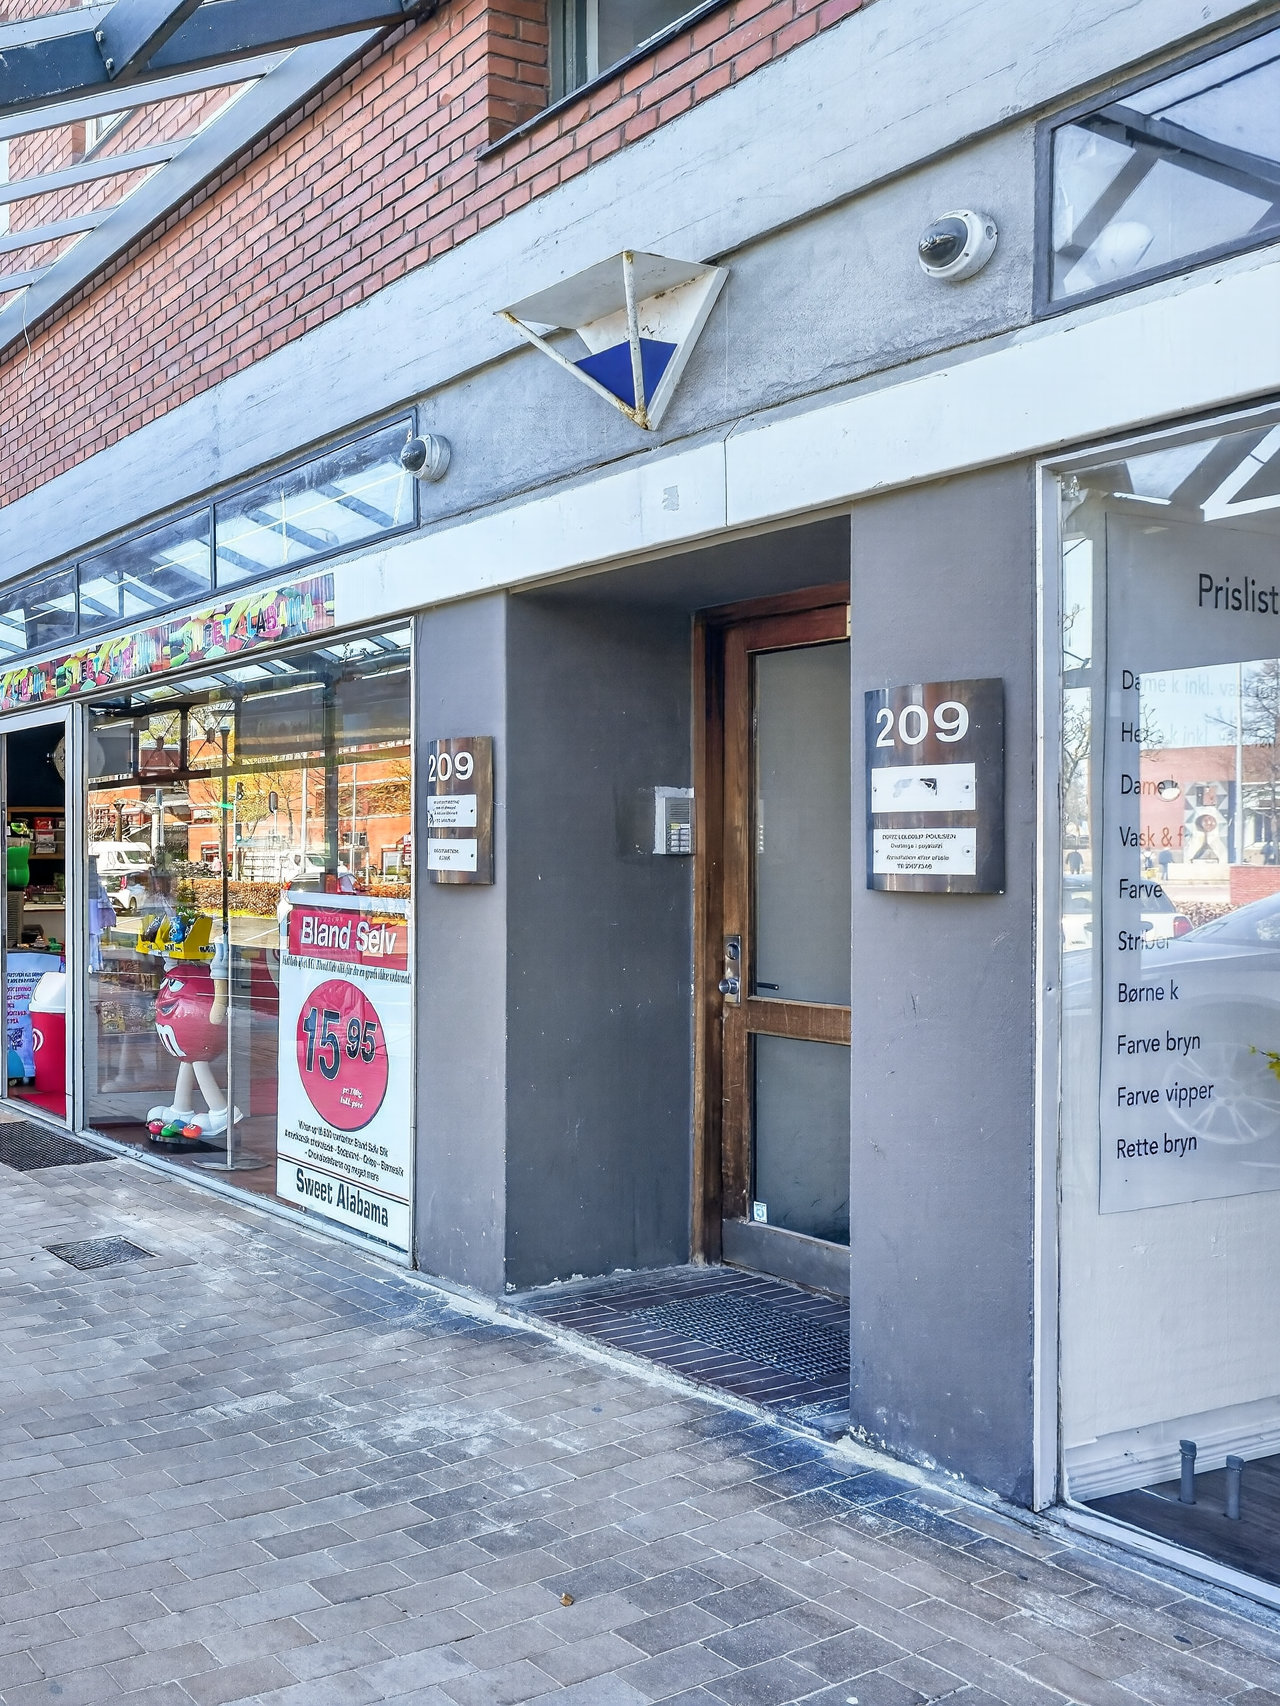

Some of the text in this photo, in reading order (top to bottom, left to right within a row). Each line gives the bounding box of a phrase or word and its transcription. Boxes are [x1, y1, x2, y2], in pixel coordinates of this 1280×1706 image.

[1198, 573, 1280, 615] Prislist
[876, 701, 969, 748] 209
[428, 751, 474, 782] 209
[1121, 774, 1164, 795] Dame
[1119, 825, 1155, 847] Vask
[1160, 826, 1173, 848] &
[1119, 878, 1163, 899] Farve
[300, 916, 397, 956] Bland Selv
[1118, 930, 1170, 951] Striber
[1118, 979, 1179, 1003] Børne k
[1117, 1030, 1201, 1056] Farve bryn
[1117, 1082, 1214, 1109] Farve vipper
[1117, 1132, 1198, 1159] Rette bryn
[296, 1167, 389, 1228] Sweet Alabama
